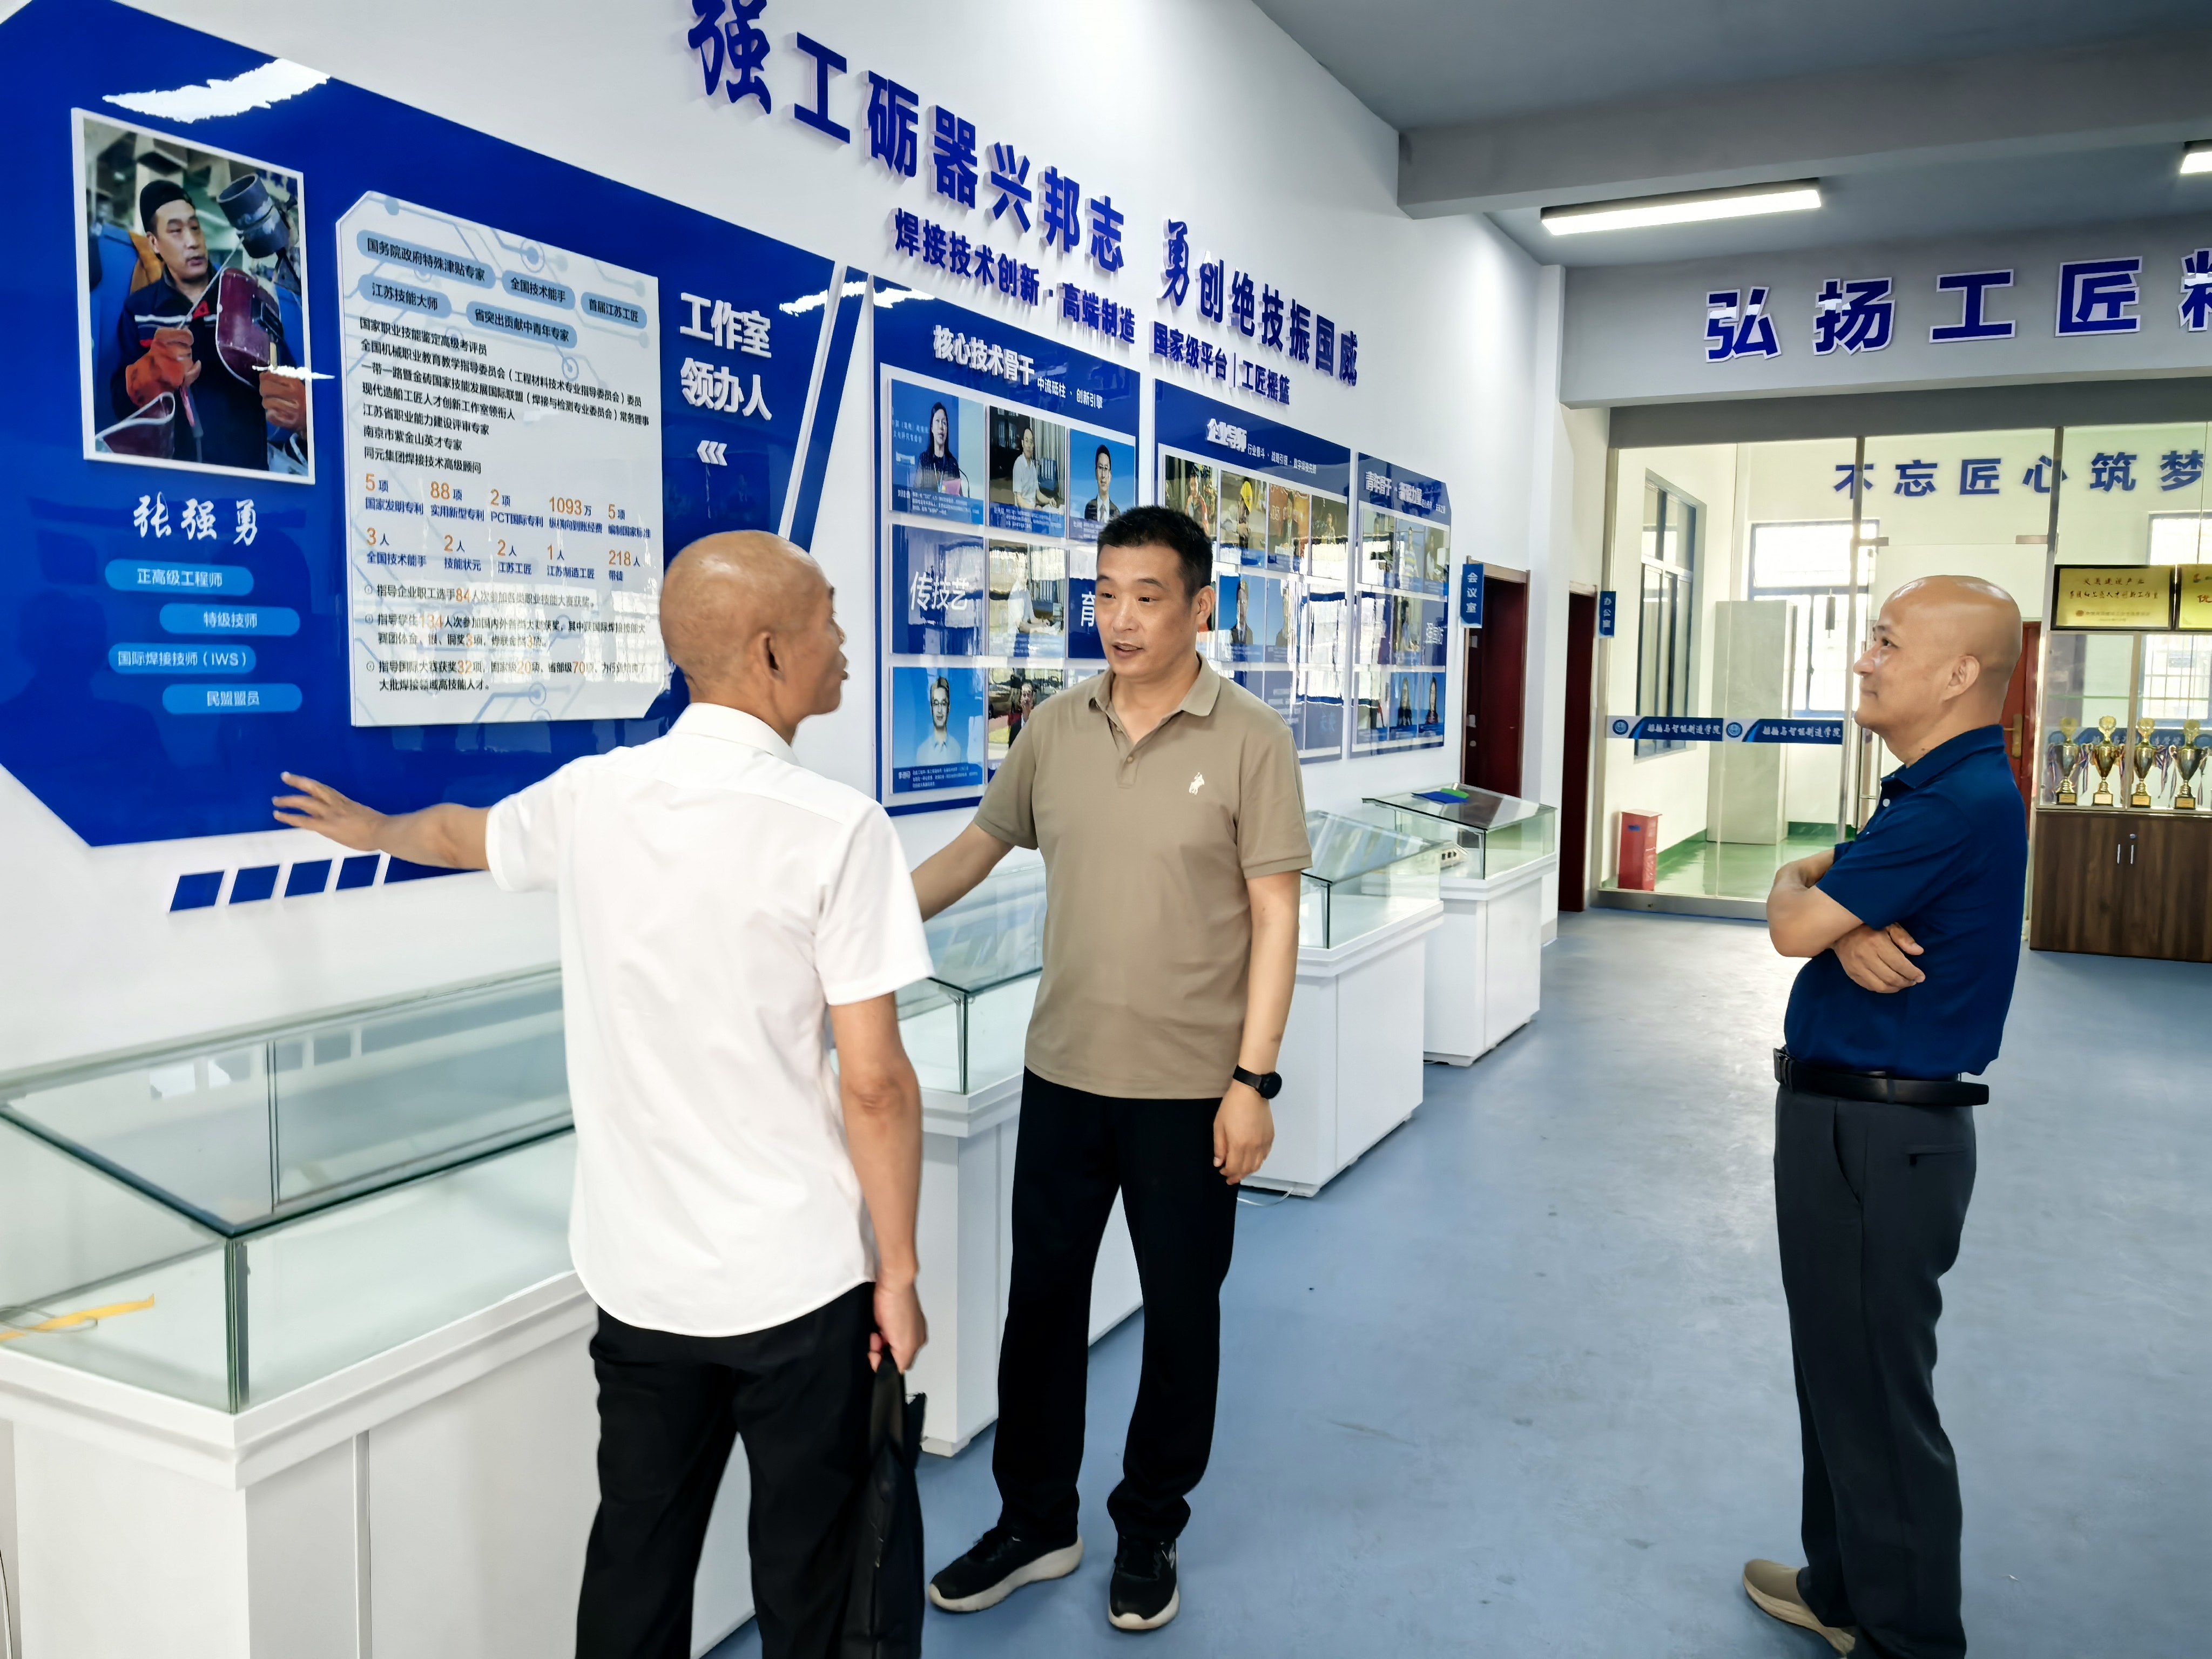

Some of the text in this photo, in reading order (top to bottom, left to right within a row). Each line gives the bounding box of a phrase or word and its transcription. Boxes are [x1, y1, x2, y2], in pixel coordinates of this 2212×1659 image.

[686, 0, 1358, 387] 强工砺器兴邦志 勇创绝技振国威
[367, 237, 485, 282] 国务院政府特殊津贴专家
[372, 282, 438, 312] 江苏技能大师
[510, 277, 566, 303] 全国技术能手
[475, 308, 569, 342] 省突出贡献中青年专家
[588, 298, 639, 323] 首届江苏工匠
[679, 292, 772, 359] 工作室
[360, 316, 487, 356] 国家职业技能鉴定高级考评员
[933, 325, 1035, 386] 核心技术骨干
[362, 381, 515, 421] 现代造船工匠人才创新工作室领衔人
[680, 357, 772, 421] 领办人
[363, 402, 489, 435] 江苏省职业能力建设评审专家
[363, 425, 462, 451] 南京市紫金山英才专家
[1833, 450, 2204, 500] 不忘匠心筑梦
[133, 491, 258, 546] 张强勇
[365, 496, 424, 516] 国家发明专利
[430, 504, 484, 522] 实用新型专利
[490, 511, 543, 528] PCT国际专利
[366, 550, 427, 567] 全国技术能手
[444, 557, 482, 571] 技能状元
[497, 561, 532, 575] 江苏工匠
[547, 564, 595, 579] 江苏制造工匠
[137, 568, 222, 588] 正高级工程师
[910, 571, 969, 611] 传技艺
[1466, 572, 1478, 613] 会议室
[203, 612, 258, 628] 特级技师
[207, 691, 260, 706] 民盟盟员
